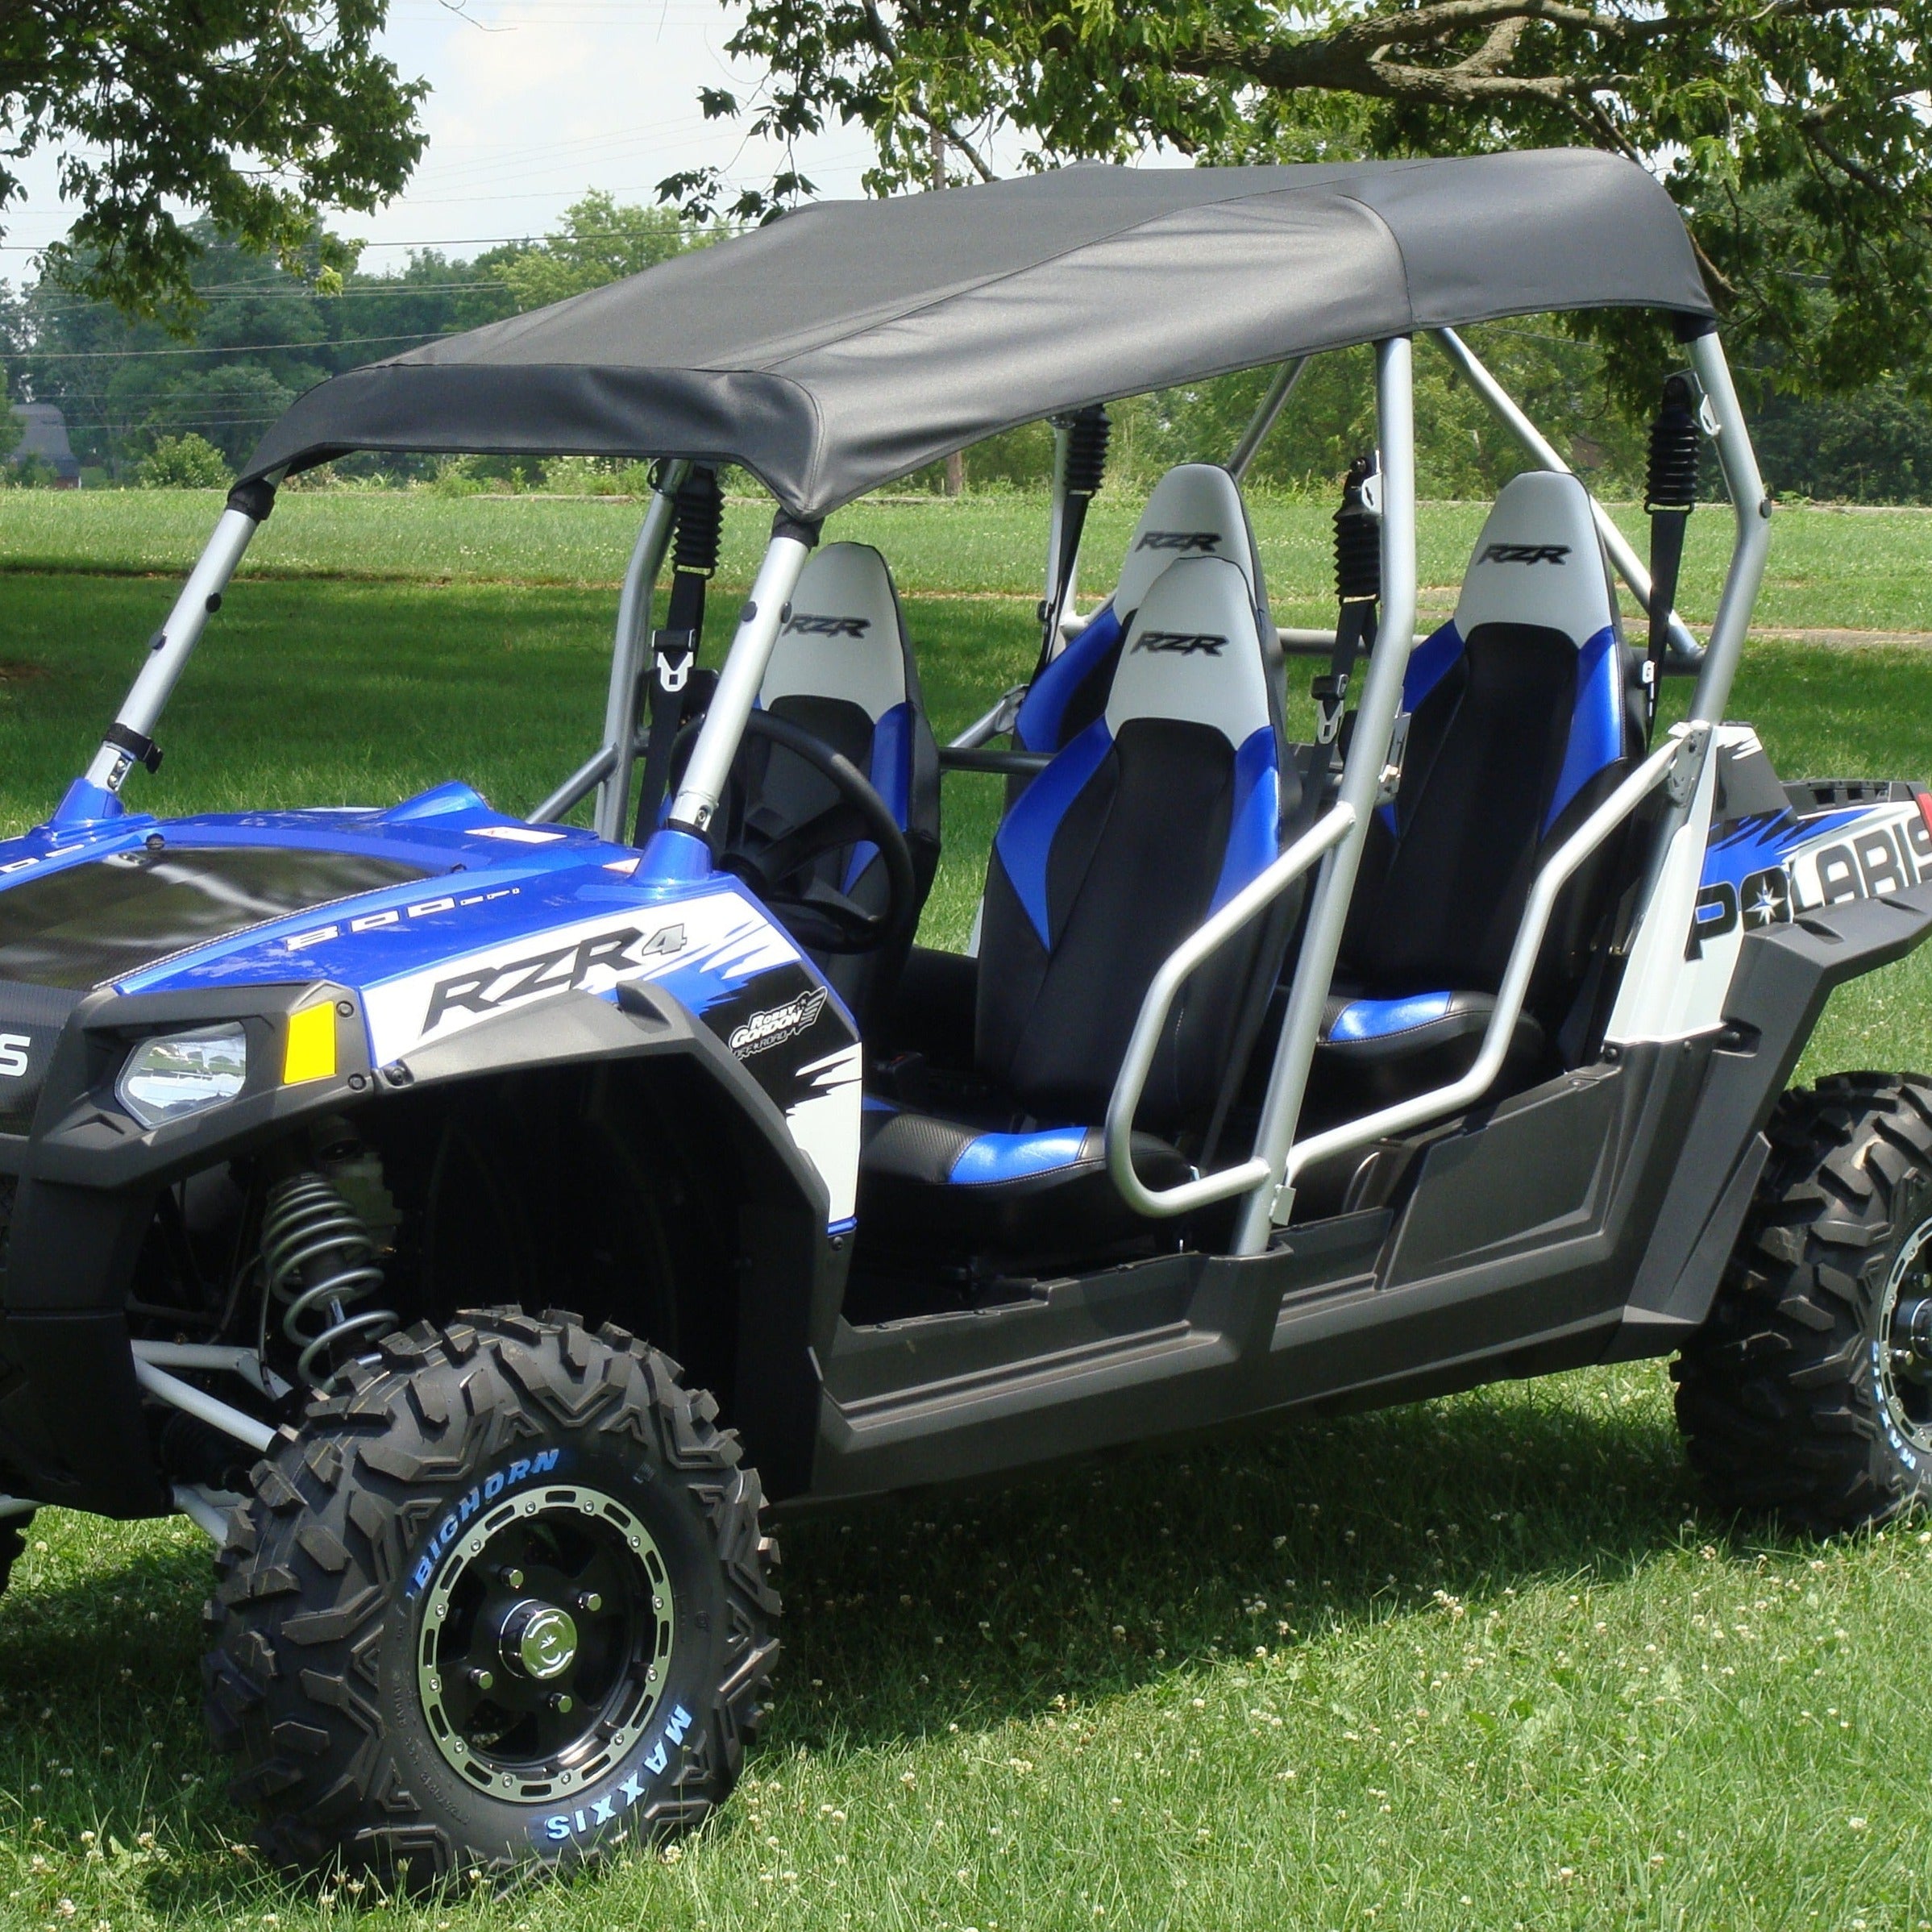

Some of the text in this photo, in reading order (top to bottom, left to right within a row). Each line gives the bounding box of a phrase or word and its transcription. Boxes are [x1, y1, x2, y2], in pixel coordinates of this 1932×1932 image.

[1135, 531, 1222, 552] RZR
[1476, 542, 1573, 566] RZR
[782, 613, 871, 638] RZR
[1130, 631, 1229, 657] RZR
[418, 923, 688, 1040] RZR 4
[731, 1010, 803, 1049] GORDON
[413, 1448, 559, 1589] BIGHORN
[546, 1704, 693, 1840] MAXXIS
